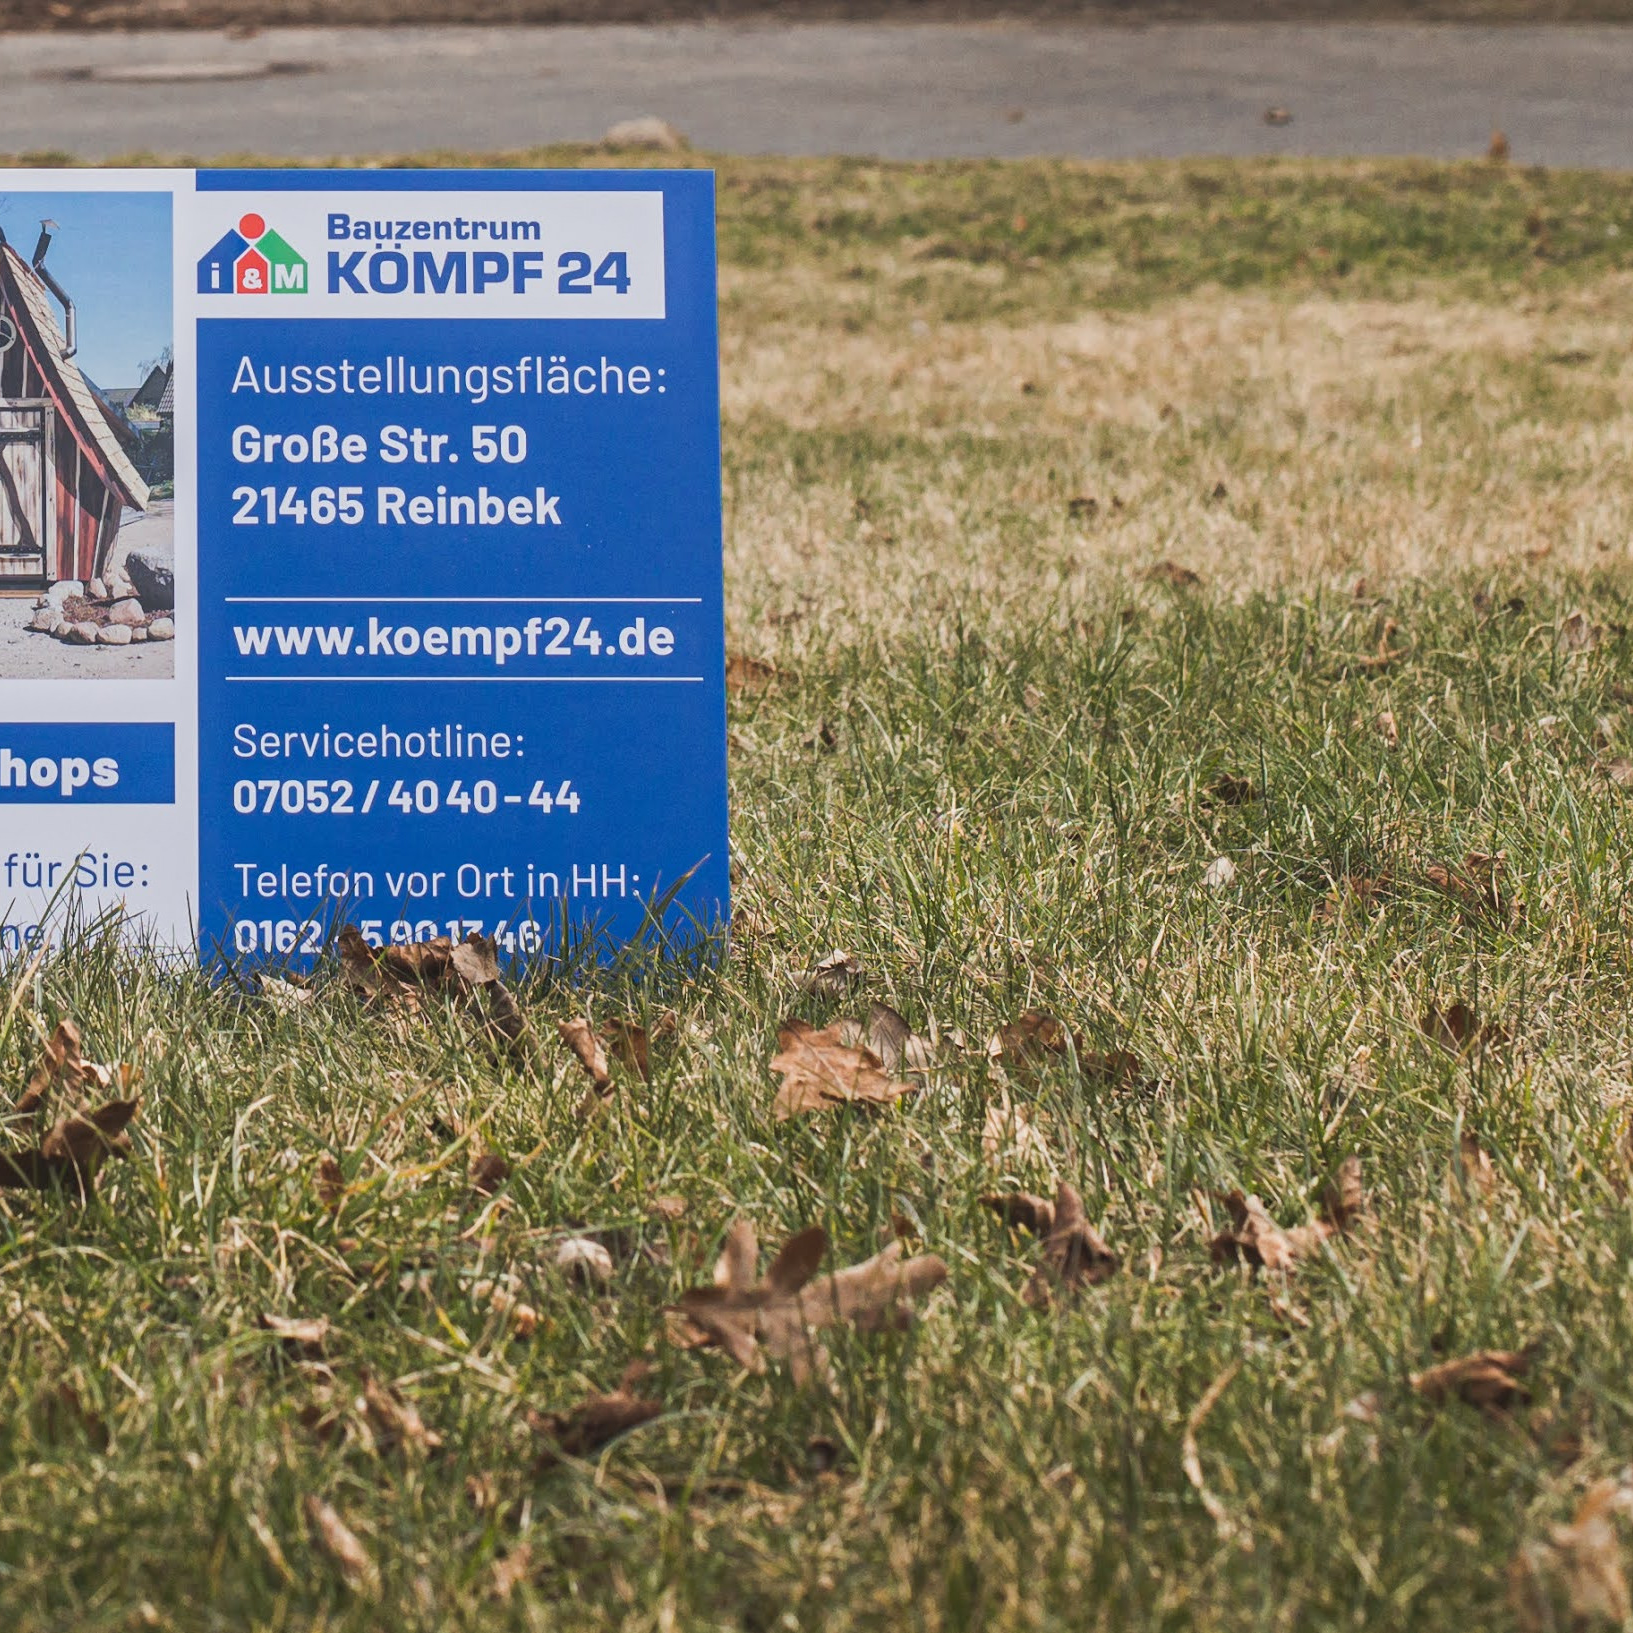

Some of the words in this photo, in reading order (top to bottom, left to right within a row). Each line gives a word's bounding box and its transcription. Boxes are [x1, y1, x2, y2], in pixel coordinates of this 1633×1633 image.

[327, 213, 541, 240] Bauzentrum
[327, 243, 544, 294] KÖMPF
[557, 251, 631, 294] 24
[231, 355, 668, 404] Ausstellungsfläche:
[231, 425, 367, 464] Große
[379, 425, 459, 464] Str.
[471, 425, 528, 464] 50
[232, 486, 364, 525] 21465
[377, 485, 562, 525] Reinbek
[233, 616, 675, 665] www.koempf24.de
[233, 723, 525, 758] Servicehotline:
[5, 853, 62, 888] für
[74, 853, 149, 888] Sie:
[234, 863, 374, 898] Telefon
[386, 868, 446, 898] vor
[457, 863, 515, 898] Ort
[528, 863, 560, 897] in
[572, 863, 641, 898] HH:
[234, 919, 323, 954] 0162
